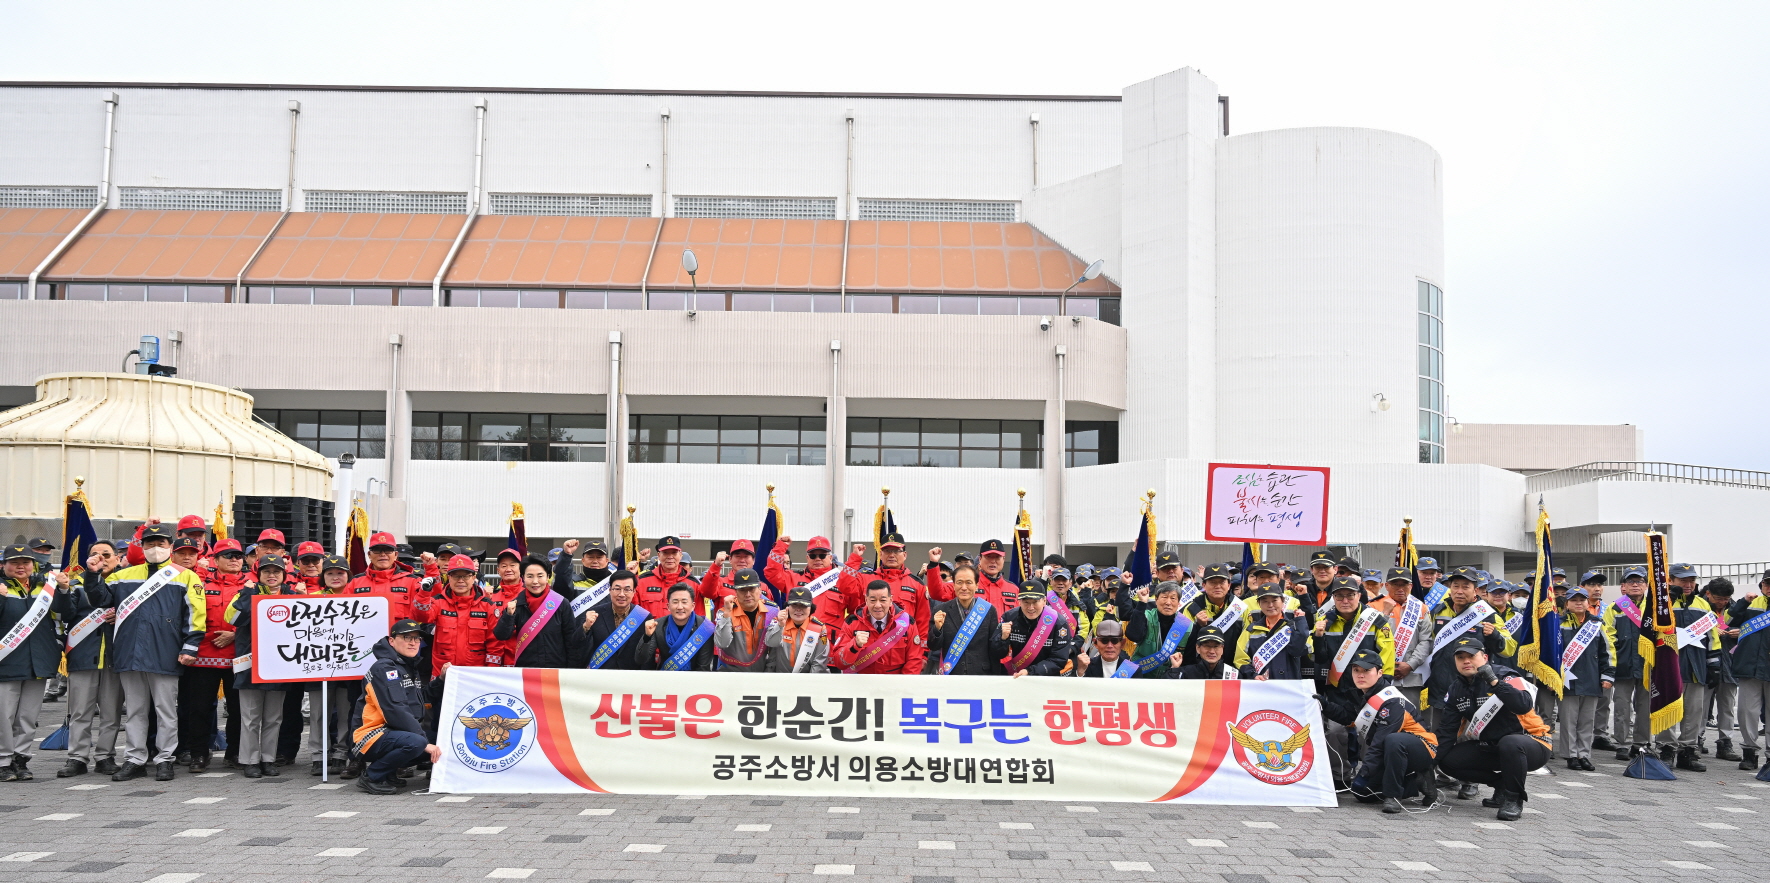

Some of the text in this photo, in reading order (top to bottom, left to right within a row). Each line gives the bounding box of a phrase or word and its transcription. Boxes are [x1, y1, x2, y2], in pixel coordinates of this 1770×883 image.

[1266, 471, 1308, 492] 습관
[1233, 486, 1303, 513] 불씨는 순간
[1227, 511, 1303, 538] 피해는 평생
[268, 606, 288, 618] SAFETY
[285, 599, 378, 629] 안전수칙은
[294, 625, 335, 641] 마음에
[276, 641, 373, 664] 대피로는
[302, 663, 323, 674] 몸으로
[465, 695, 527, 716] 공주소방서
[590, 693, 1178, 748] 산불은 한순간! 복구는 한평생
[1241, 712, 1298, 729] VOLUNTEER FIRE
[456, 742, 528, 770] Gongju Fire Station
[712, 754, 1055, 785] 공주소방서 의용소방대연합회
